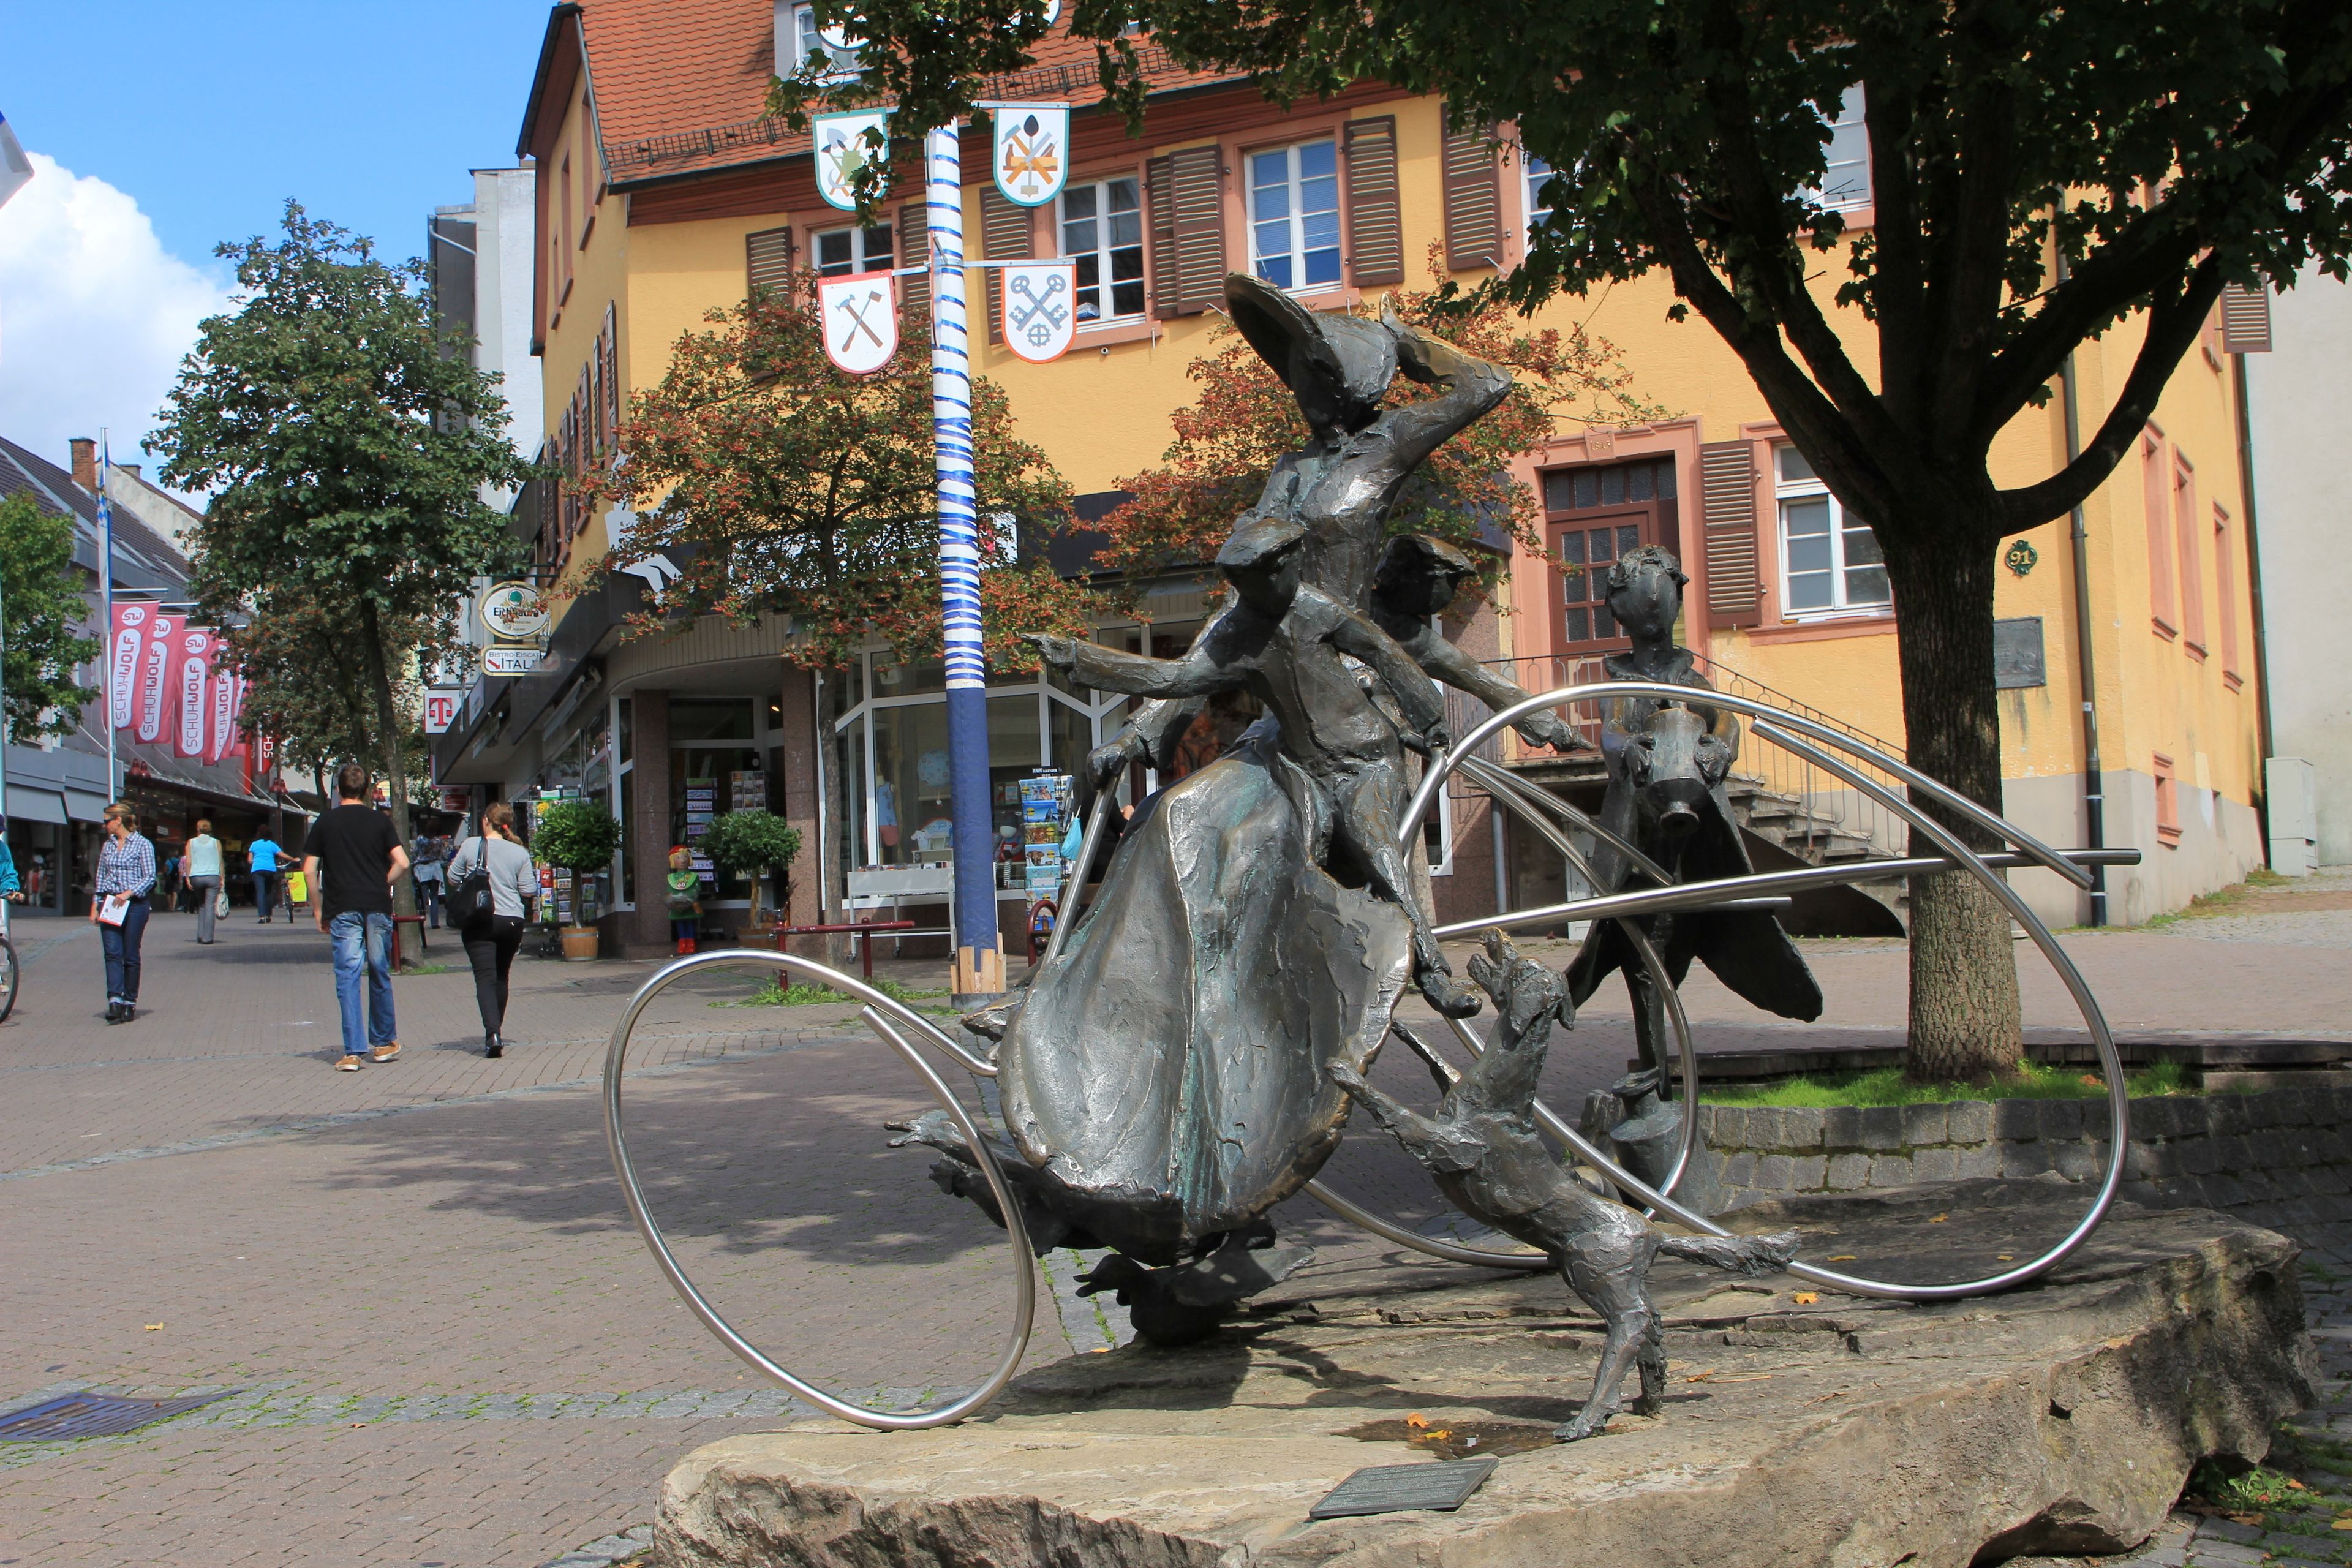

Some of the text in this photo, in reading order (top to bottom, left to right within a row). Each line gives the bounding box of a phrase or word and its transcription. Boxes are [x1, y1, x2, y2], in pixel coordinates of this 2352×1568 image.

[2010, 550, 2031, 565] 91
[493, 606, 540, 618] Eichaum
[115, 636, 135, 721] SCHUHWOLF
[143, 649, 161, 733] SCHUHWOLF
[186, 665, 200, 748] SCHUHWOLF
[429, 697, 453, 726] T
